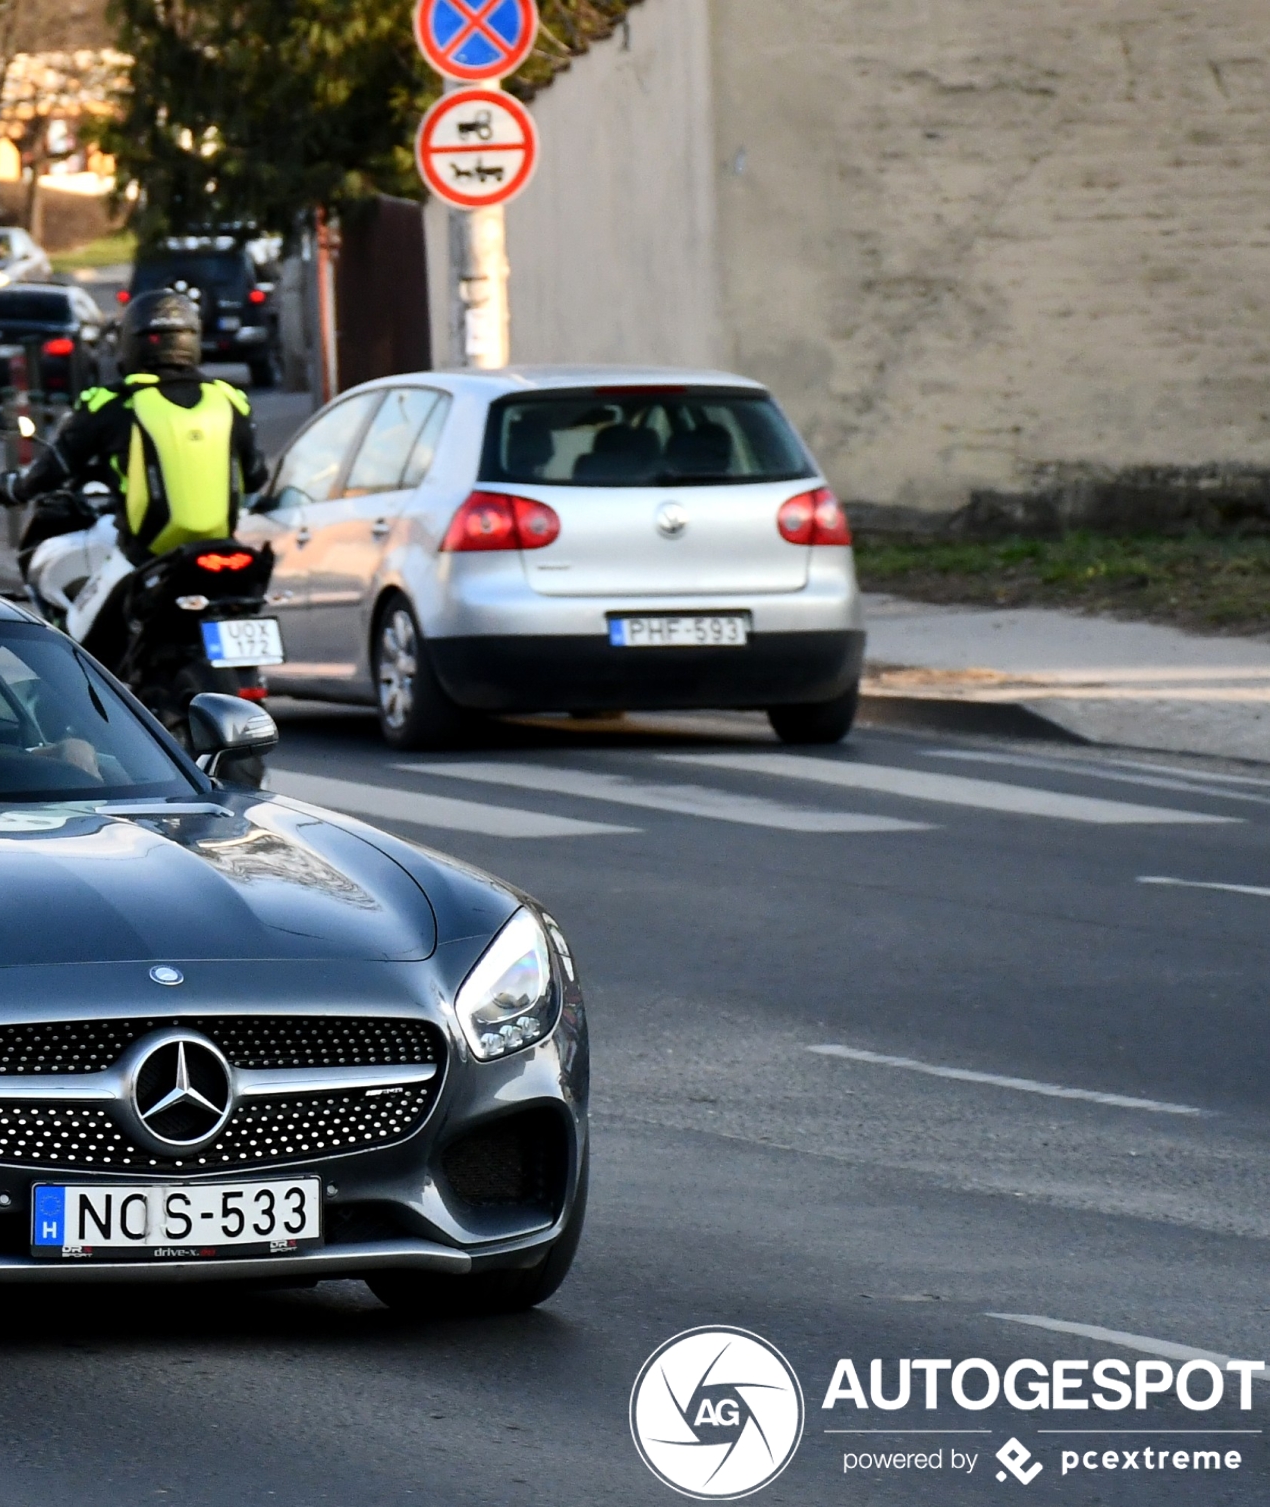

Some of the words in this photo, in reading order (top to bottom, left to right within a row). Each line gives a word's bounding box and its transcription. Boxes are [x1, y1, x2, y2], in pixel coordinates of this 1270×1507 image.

[228, 623, 270, 638] UOX
[629, 618, 738, 641] PHF-593
[237, 640, 270, 655] 172
[42, 1221, 57, 1239] H
